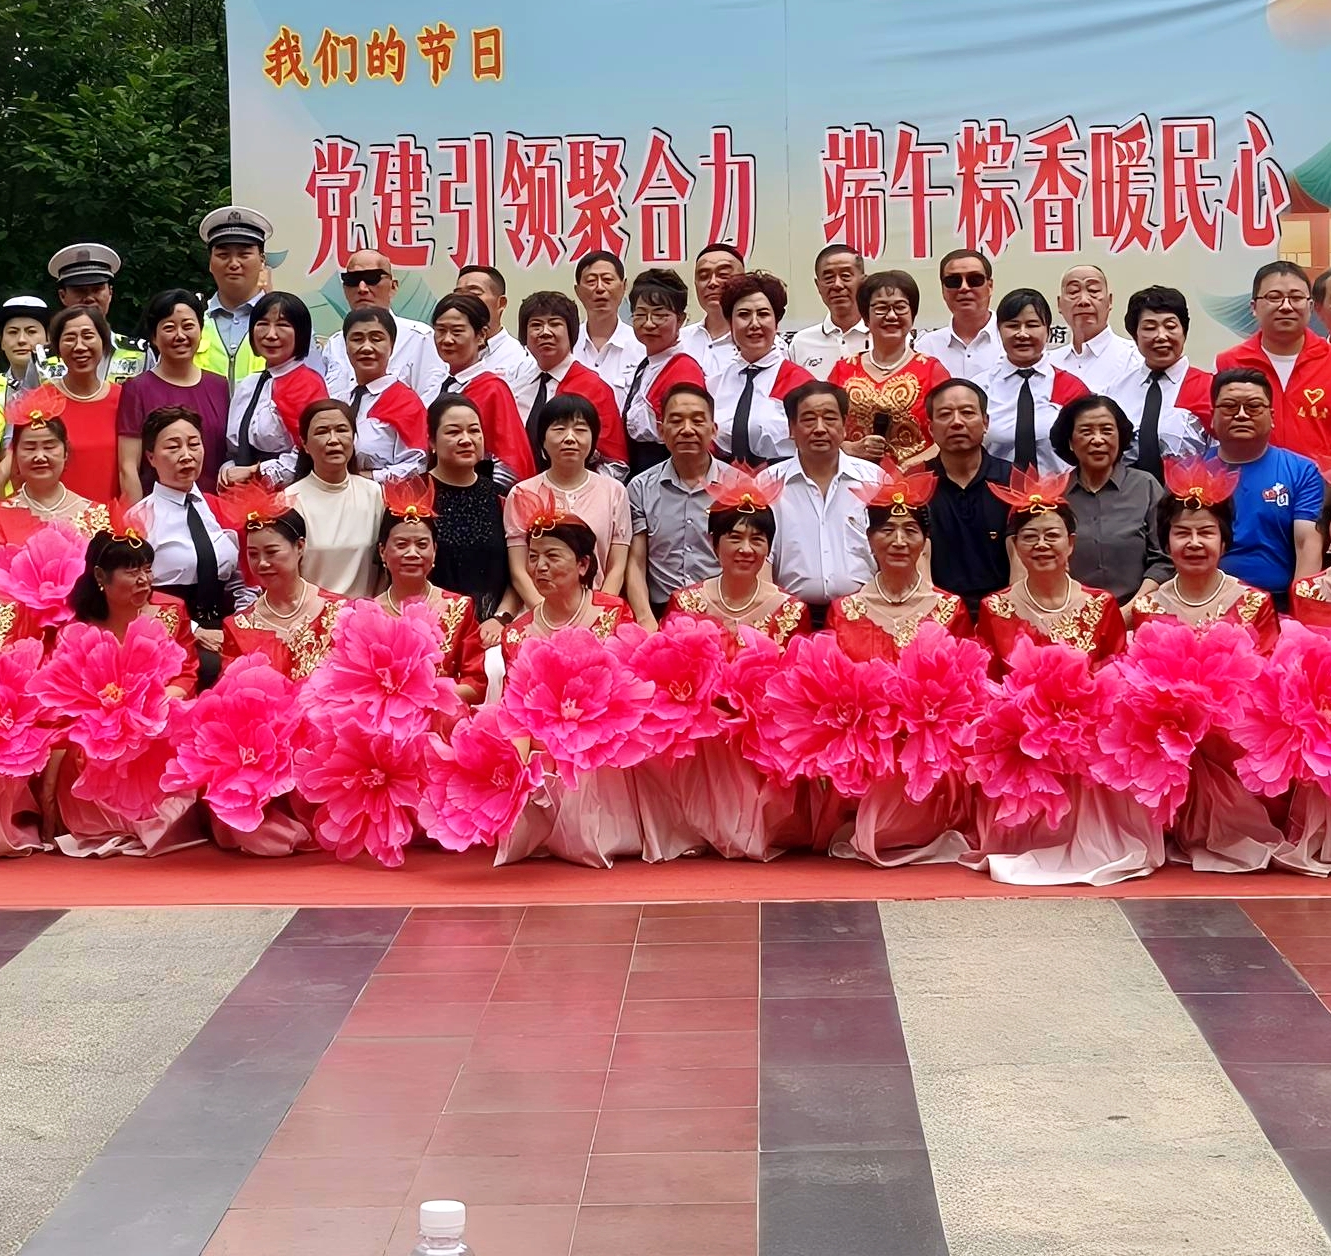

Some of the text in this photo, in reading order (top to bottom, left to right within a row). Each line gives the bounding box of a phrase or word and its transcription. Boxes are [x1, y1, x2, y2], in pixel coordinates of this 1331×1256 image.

[263, 24, 506, 90] 我们的节日
[306, 112, 1291, 276] 党建引领聚合力 端午粽香暖民心
